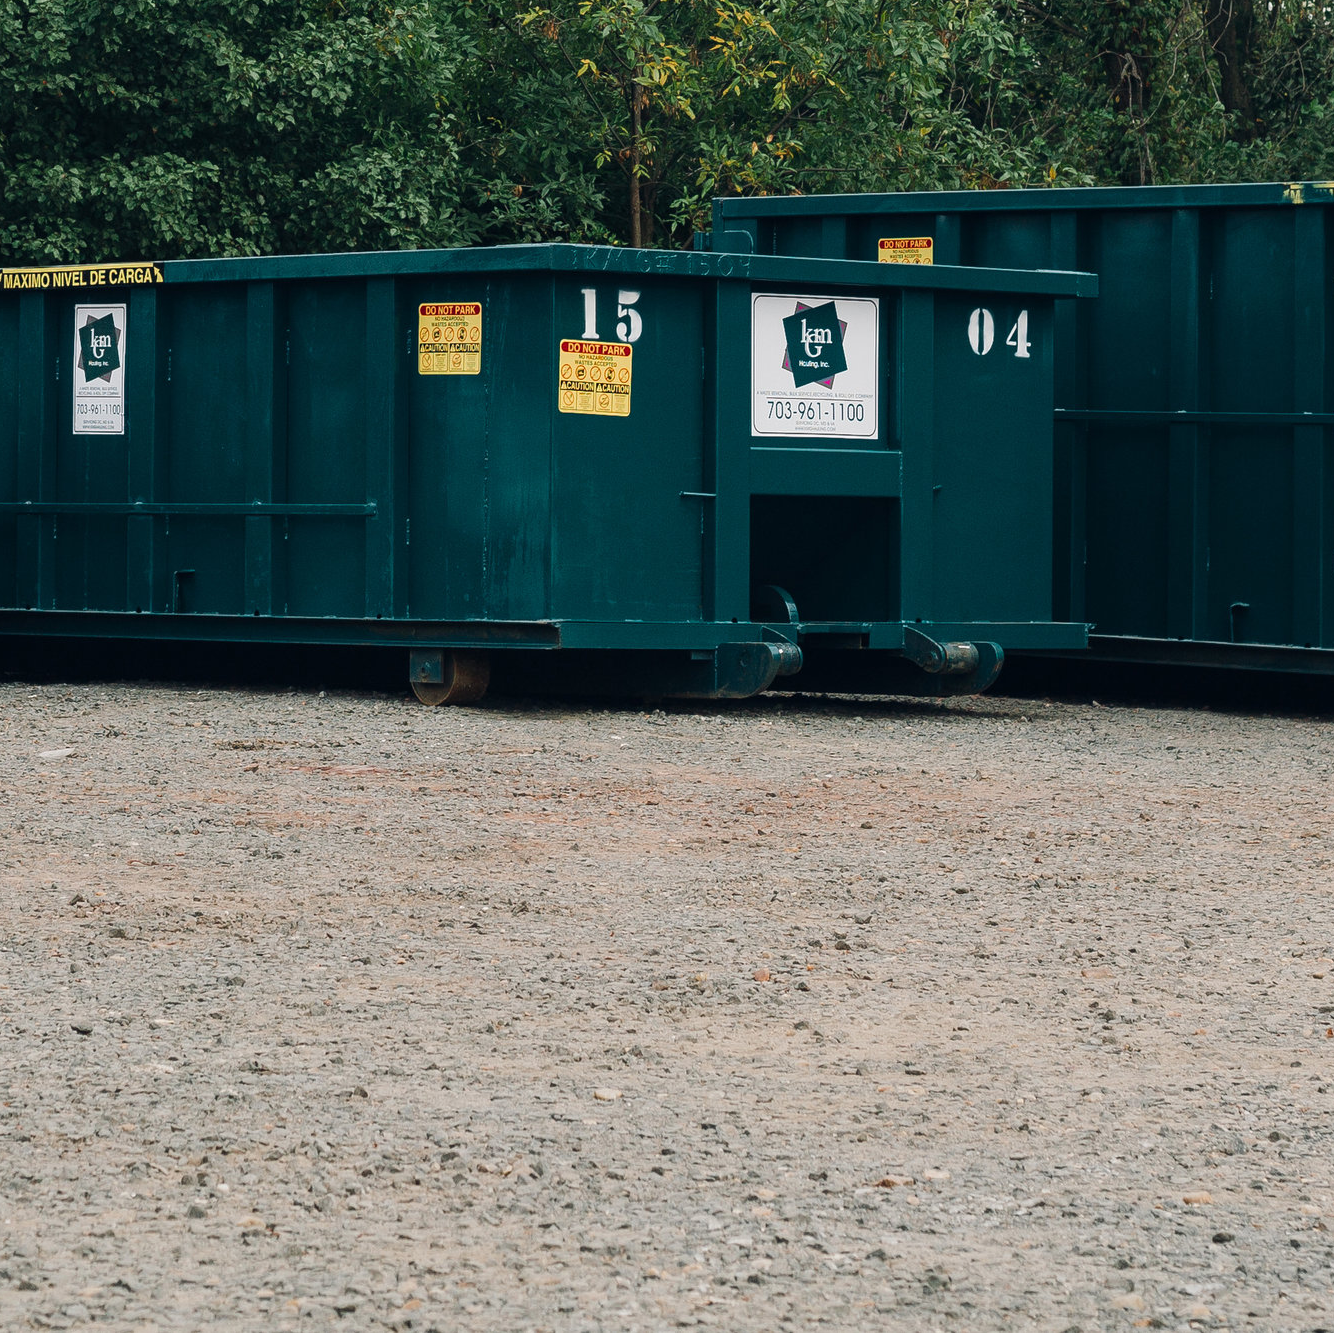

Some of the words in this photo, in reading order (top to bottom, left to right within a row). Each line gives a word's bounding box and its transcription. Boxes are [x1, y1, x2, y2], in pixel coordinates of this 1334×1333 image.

[4, 272, 50, 289] MAXIMO
[53, 271, 87, 287] NIVEL
[90, 270, 106, 285] DE
[109, 268, 152, 284] CARGA
[426, 306, 436, 315] DO
[438, 306, 453, 314] NOT
[455, 306, 475, 314] PARK
[581, 288, 642, 343] 15
[968, 307, 1031, 358] 04
[424, 344, 448, 352] CAUTION
[456, 344, 479, 352] CAUTION
[568, 343, 580, 352] DO
[582, 344, 600, 353] NOT
[602, 345, 625, 355] PARK
[567, 381, 594, 391] CAUTION
[602, 384, 628, 393] CAUTION
[77, 404, 120, 415] 703-961-1100
[768, 401, 864, 421] 703-961-1100
